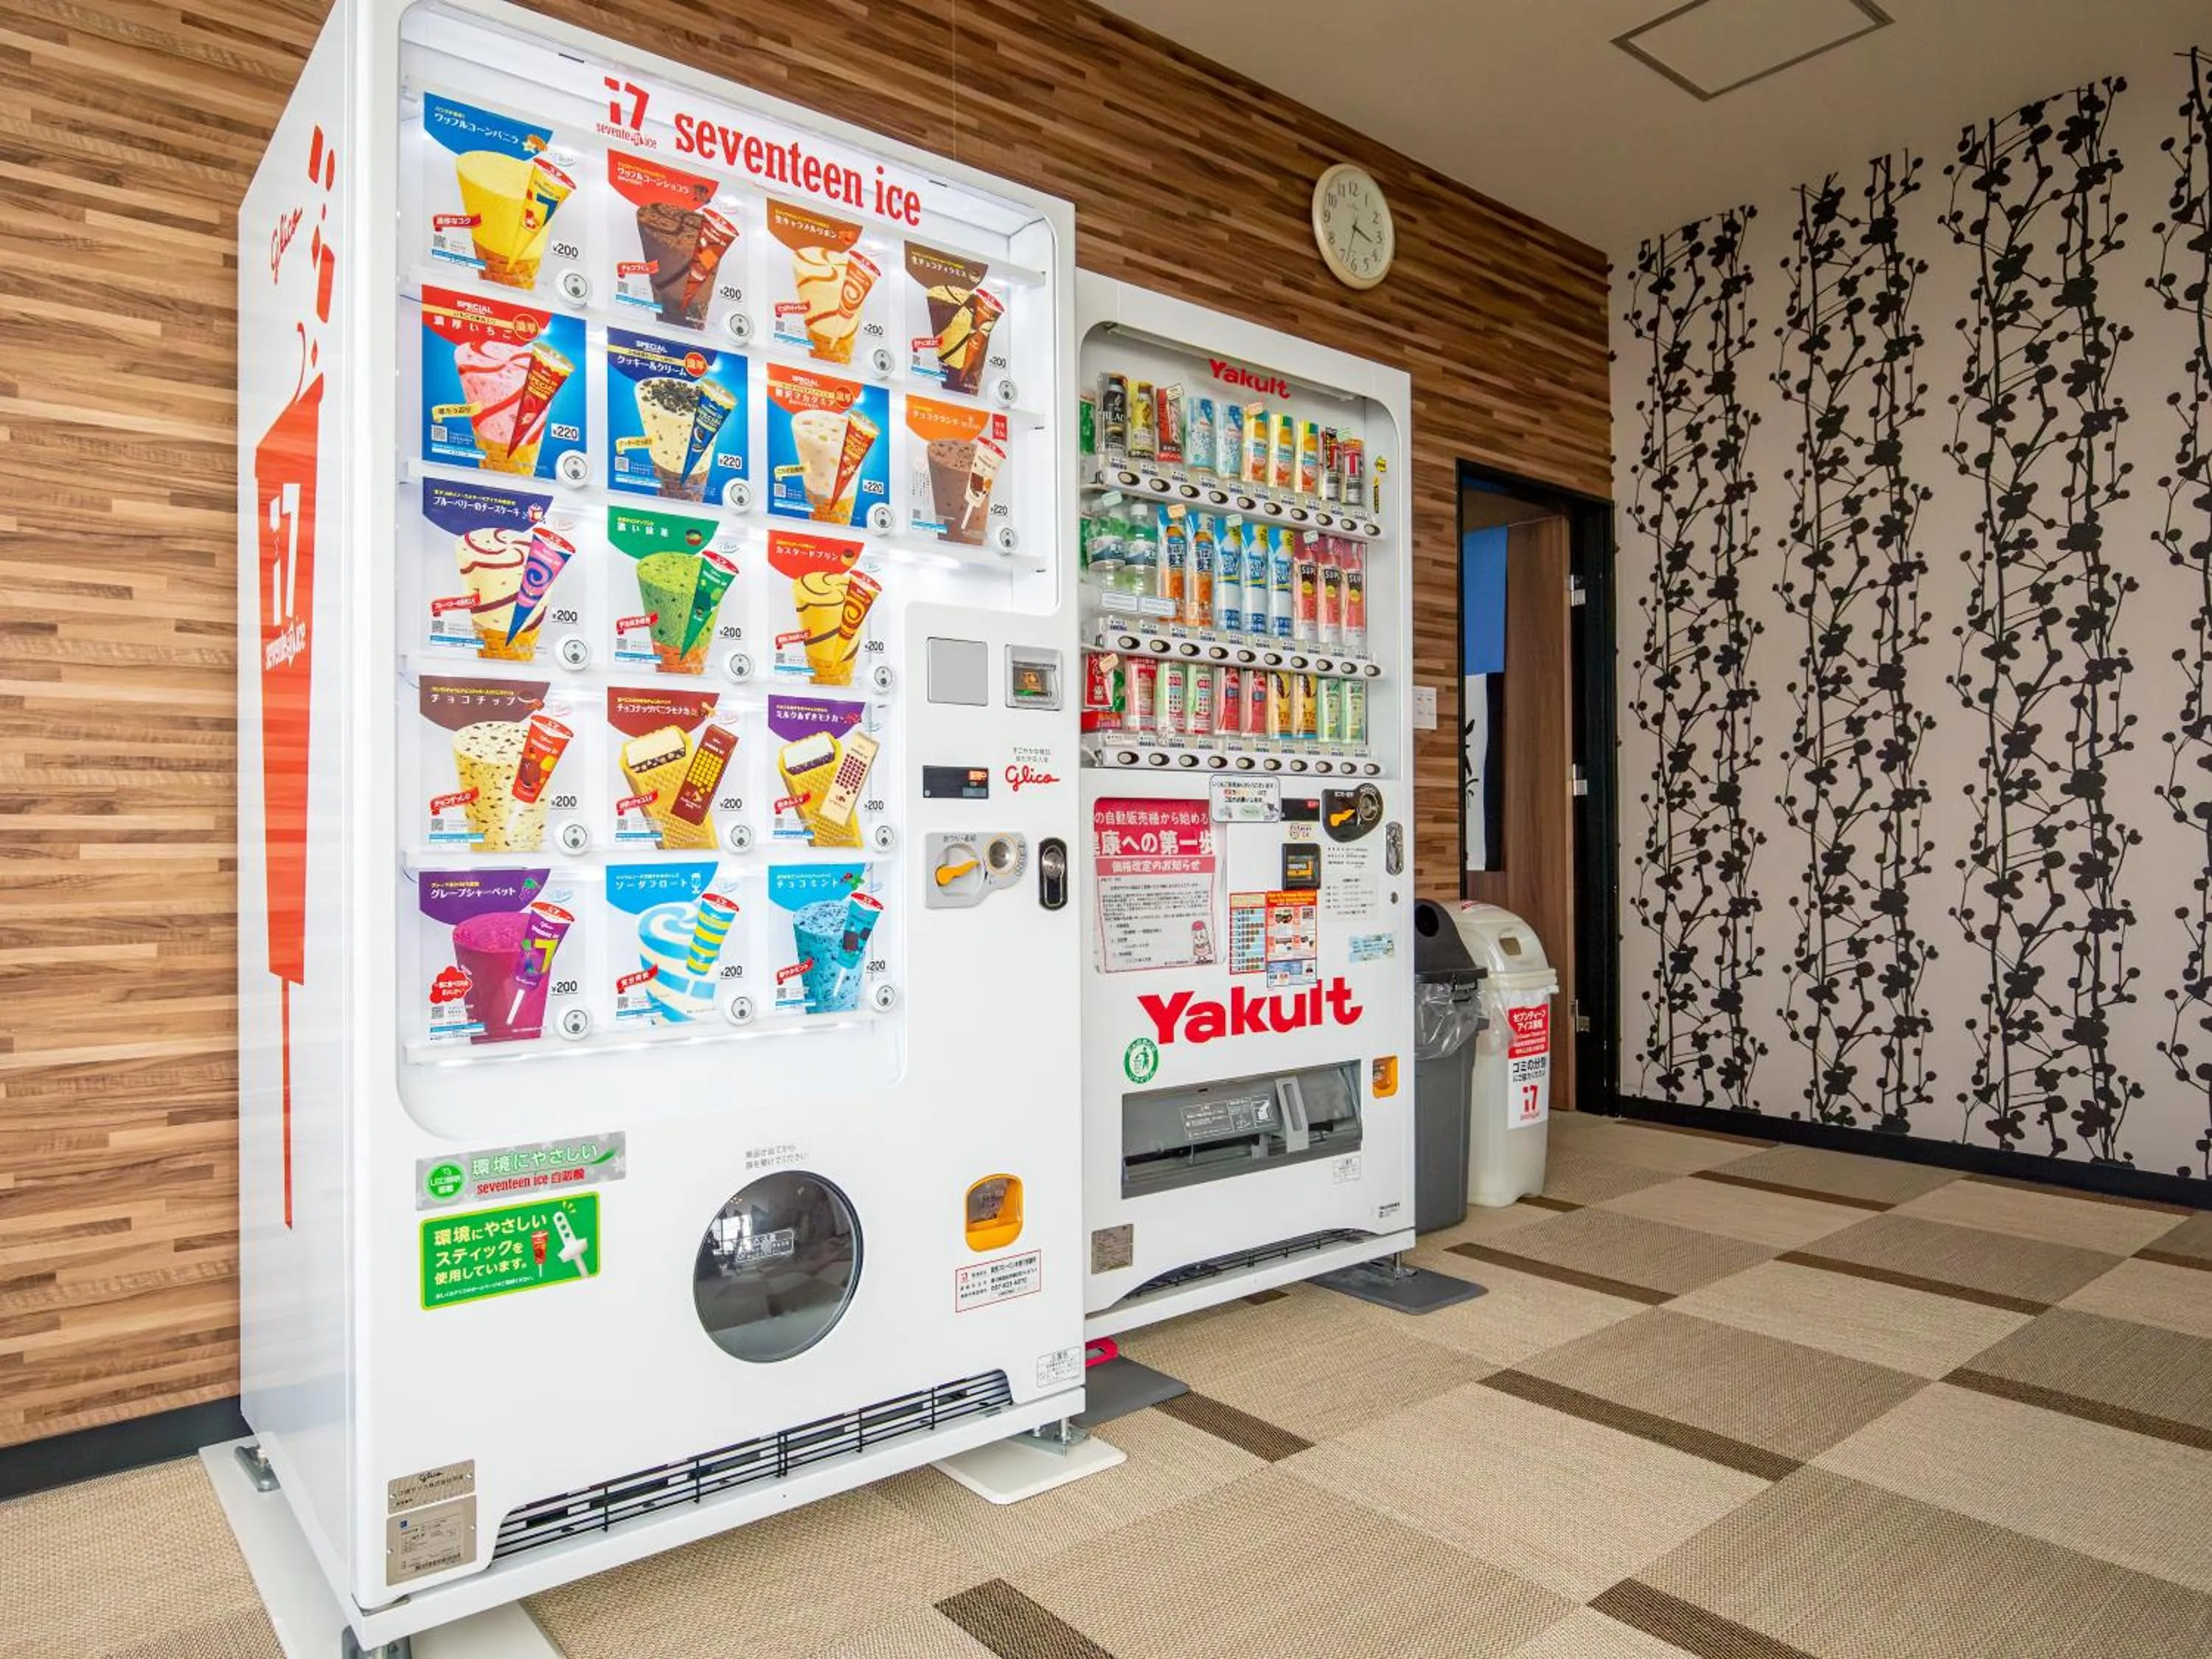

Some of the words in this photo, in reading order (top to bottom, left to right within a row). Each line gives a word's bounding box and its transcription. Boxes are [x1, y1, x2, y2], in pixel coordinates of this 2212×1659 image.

[434, 111, 519, 145] ワッフルコーンバニラ
[674, 112, 864, 209] seventeen
[874, 165, 922, 226] ice
[553, 243, 579, 259] ¥200
[720, 286, 742, 301] ¥200
[456, 300, 493, 314] SPECIAL
[636, 341, 668, 353] SPECIAL
[1208, 358, 1291, 400] Yakult
[553, 425, 578, 439] ¥220
[720, 456, 741, 468] ¥220
[863, 481, 883, 494] ¥220
[990, 504, 1009, 516] ¥220
[553, 610, 578, 622] ¥200
[720, 626, 742, 638] ¥200
[864, 641, 884, 652] ¥200
[431, 694, 517, 706] チョコチップ
[1005, 765, 1060, 791] Glico
[551, 796, 577, 808] ¥200
[719, 799, 742, 809] ¥200
[864, 800, 884, 811] ¥200
[1095, 811, 1208, 826] の自動販売機から始める
[1111, 860, 1202, 873] 価格改定のお知らせ
[616, 878, 688, 891] ソーダフロート
[776, 878, 838, 890] チョコミント
[431, 887, 516, 899] グレープシャーベット
[720, 966, 743, 978] ¥200
[866, 961, 886, 971] ¥200
[552, 981, 577, 993] ¥200
[1137, 977, 1363, 1045] Yakult
[471, 1144, 597, 1176] 環境にやさしい
[477, 1176, 531, 1195] seventeen
[533, 1173, 549, 1185] ice
[434, 1214, 547, 1246] 環境にやさしい
[435, 1240, 524, 1267] スティックを
[434, 1259, 528, 1286] 使用しています。
